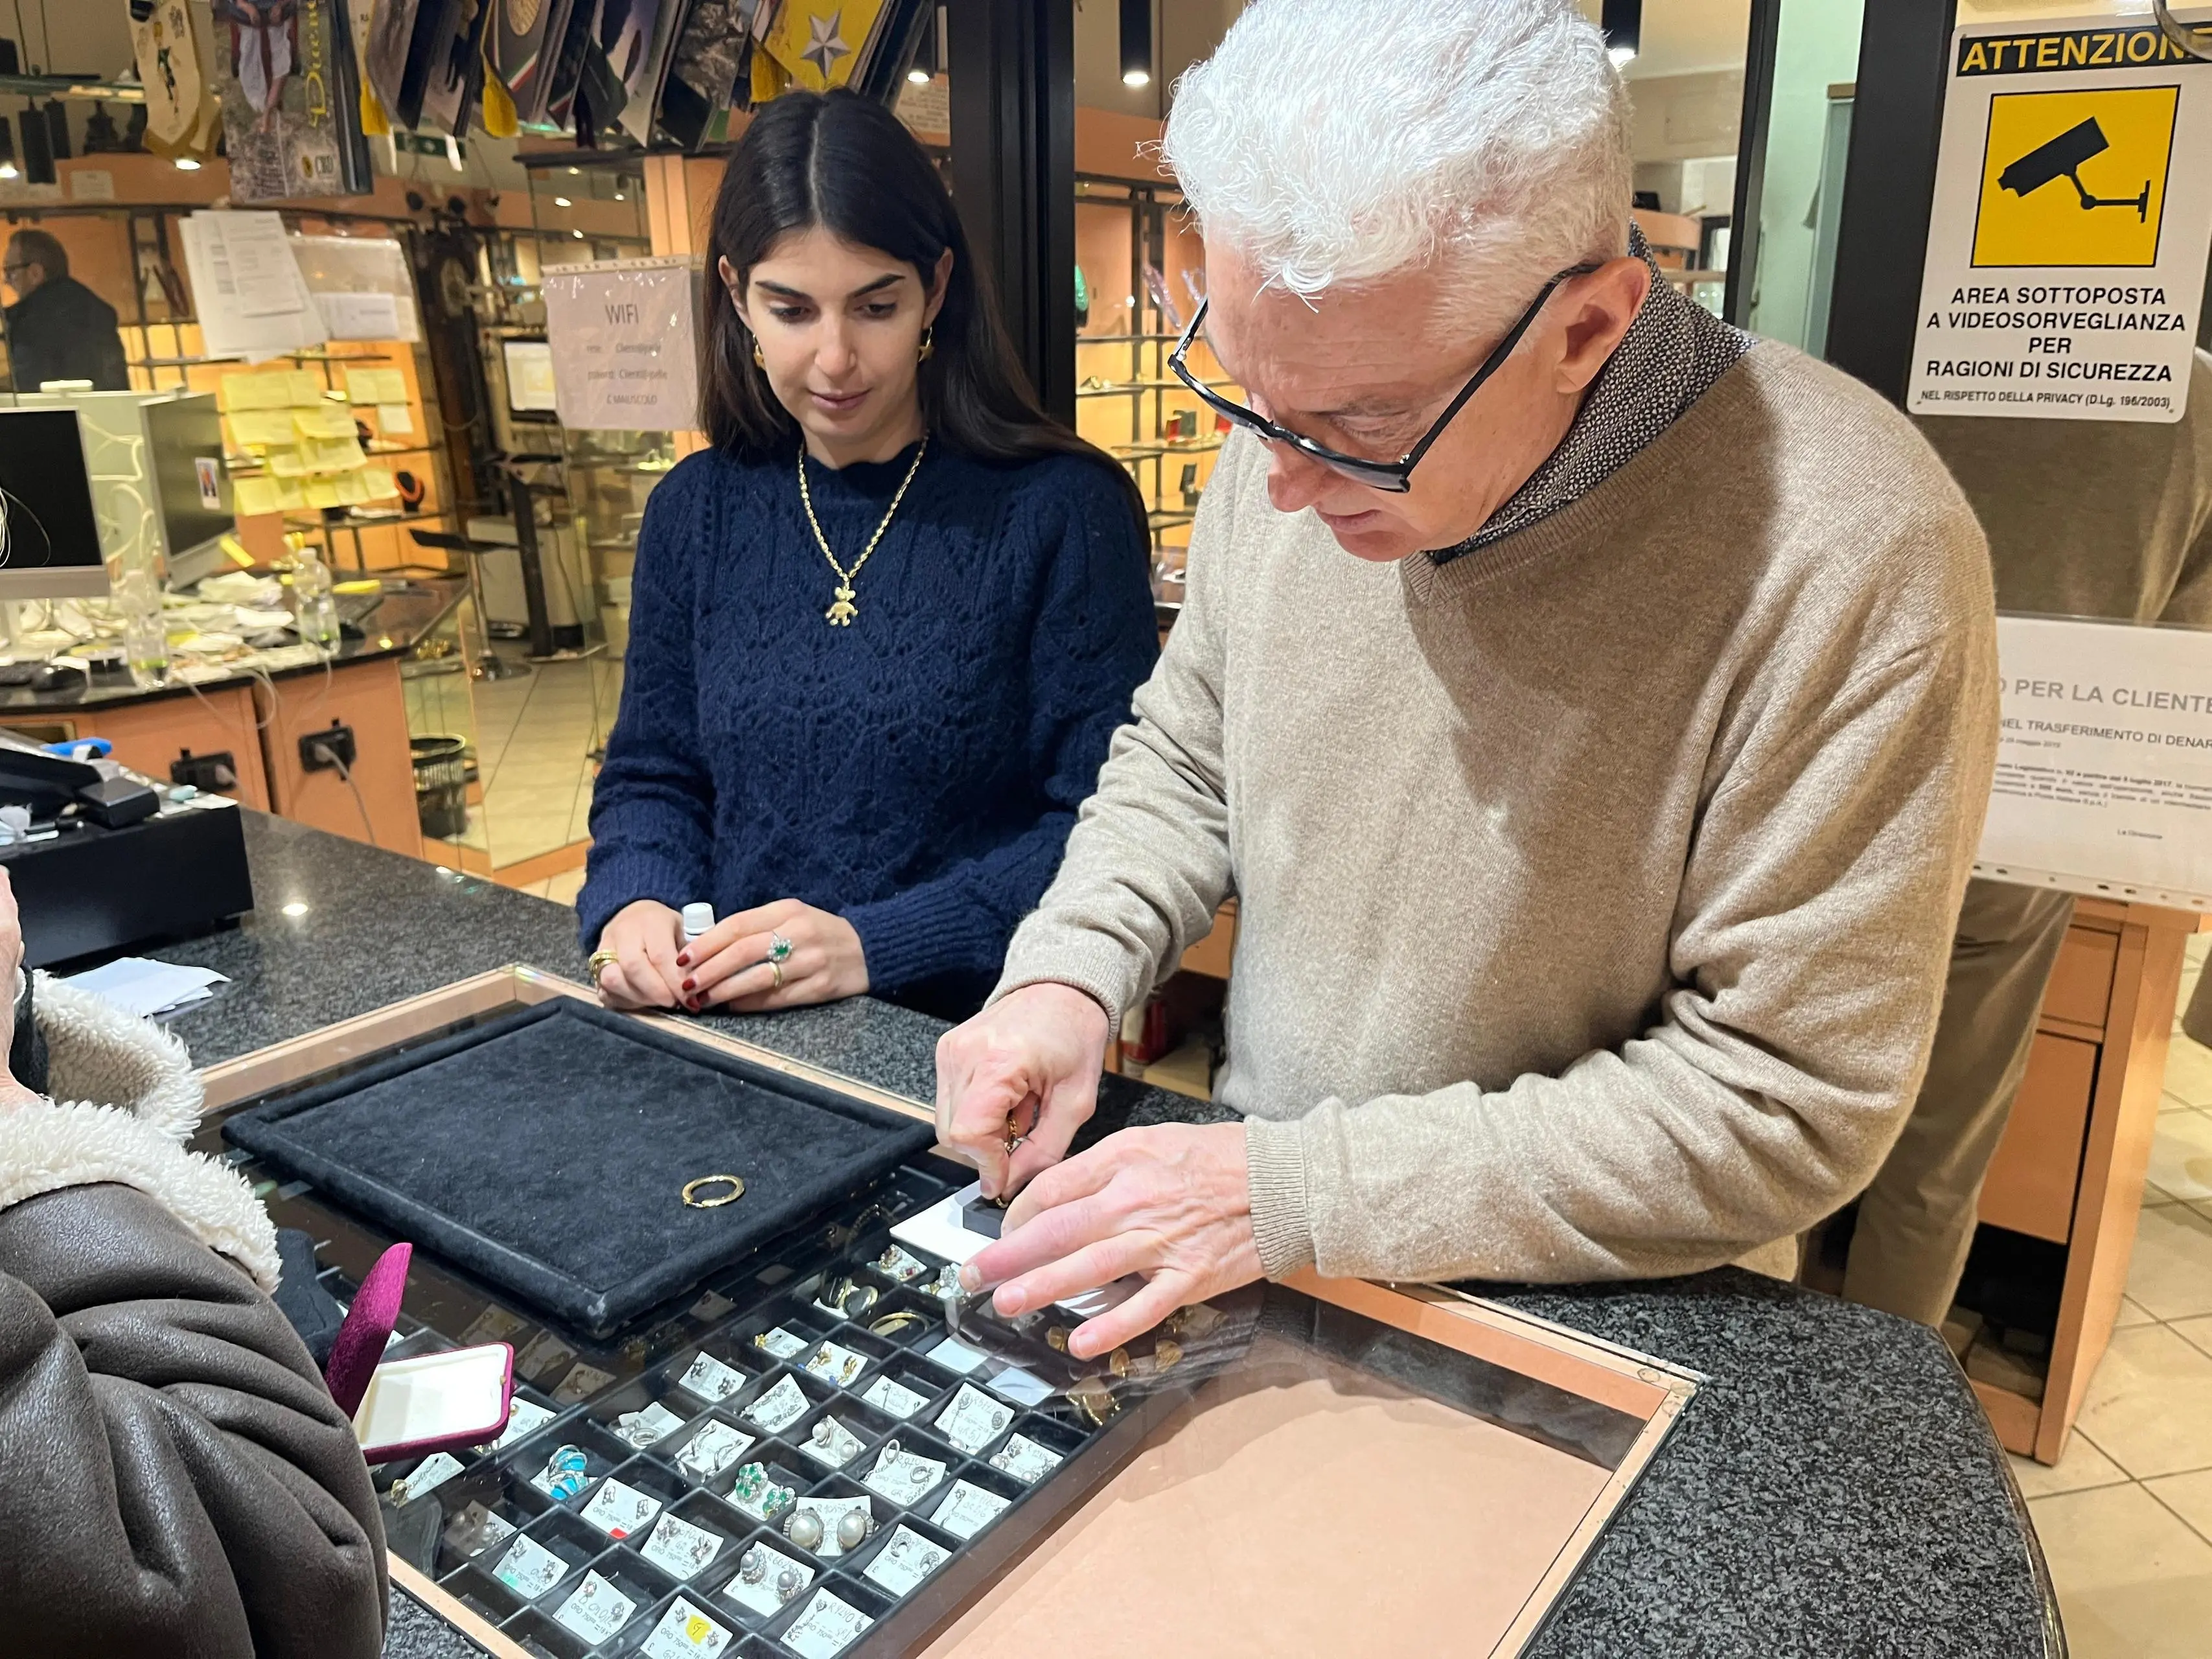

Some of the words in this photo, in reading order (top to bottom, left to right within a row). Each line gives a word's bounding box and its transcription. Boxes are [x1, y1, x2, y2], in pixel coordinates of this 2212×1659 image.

[1961, 28, 2212, 72] ATTENZION
[1951, 288, 2009, 303] AREA
[2016, 287, 2165, 305] SOTTOPOSTA
[605, 304, 639, 324] WIFI
[1927, 312, 1940, 328] A
[1949, 312, 2185, 331] VIDEOSORVEGLIANZA
[2029, 337, 2071, 353] PER
[1926, 360, 2013, 377] RAGIONI
[2020, 362, 2040, 378] DI
[2046, 362, 2172, 381] SICUREZZA
[1921, 391, 1940, 400] NEL
[1944, 391, 1996, 402] RISPETTO
[1998, 391, 2033, 402] DELLA
[2036, 393, 2083, 404] PRIVACY
[2120, 396, 2171, 409] 196/2003)
[2014, 679, 2064, 699] PER
[2072, 684, 2104, 703] LA
[2027, 720, 2144, 742] TRASFERIMENTO
[2147, 733, 2161, 743] DI
